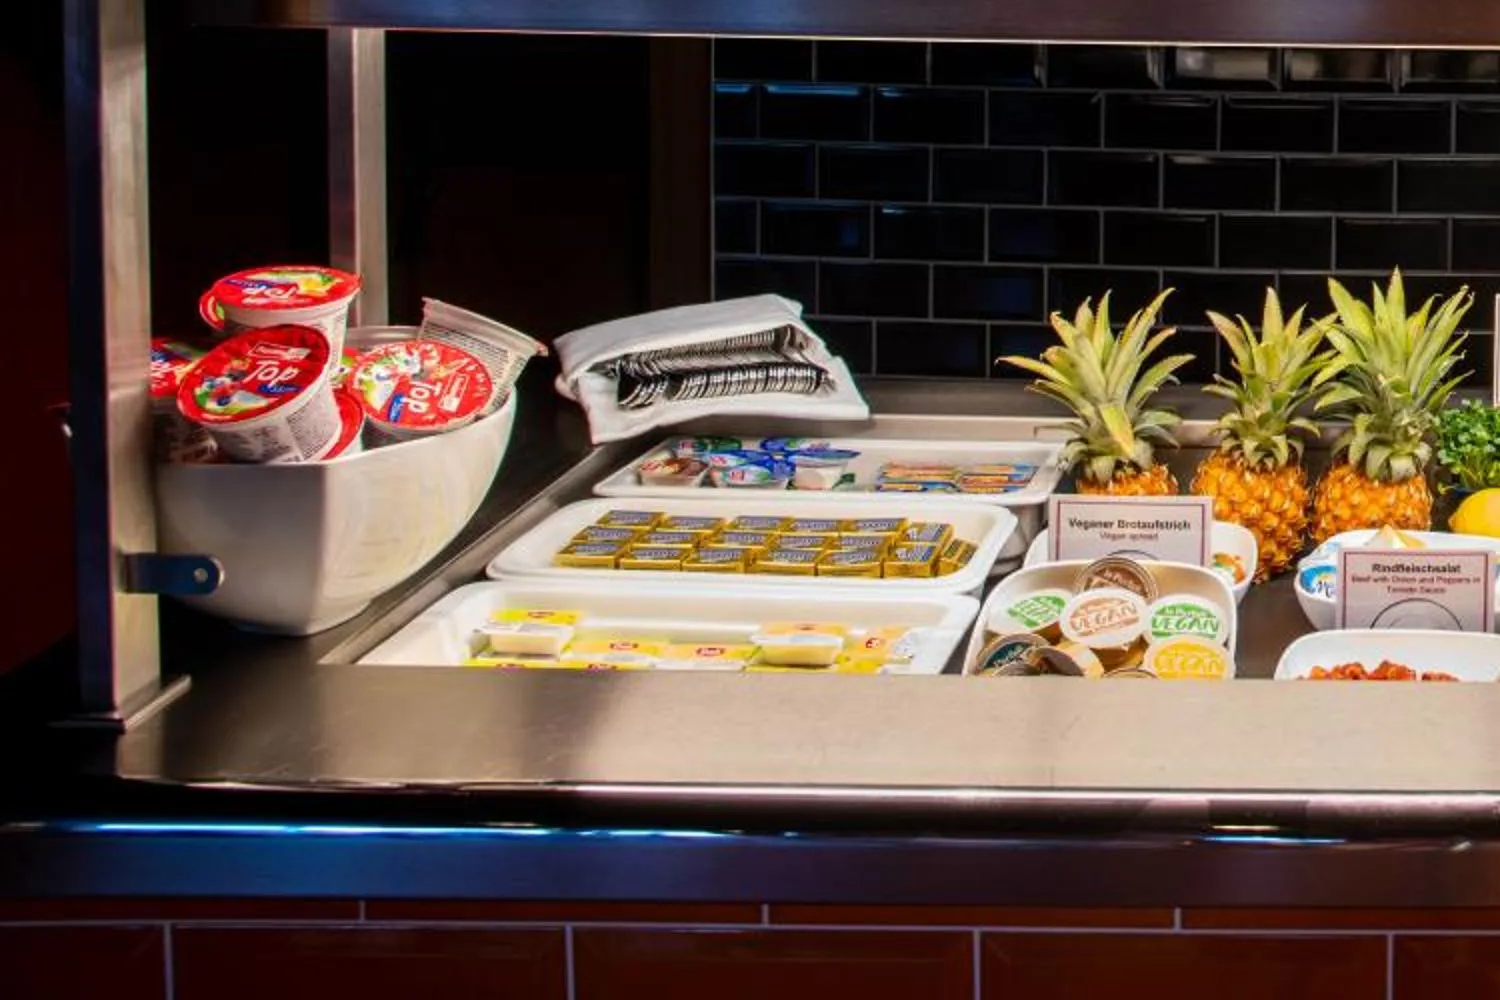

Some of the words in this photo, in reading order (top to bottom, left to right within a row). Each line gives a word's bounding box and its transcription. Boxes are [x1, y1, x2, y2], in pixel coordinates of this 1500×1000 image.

[242, 360, 300, 388] Top
[402, 380, 441, 413] Top
[1068, 518, 1114, 530] Veganer
[1117, 519, 1191, 530] Brotaufstrich
[1371, 563, 1461, 573] Rindfleischsalat
[1070, 601, 1138, 632] VEGAN
[1151, 616, 1219, 632] VEGAN
